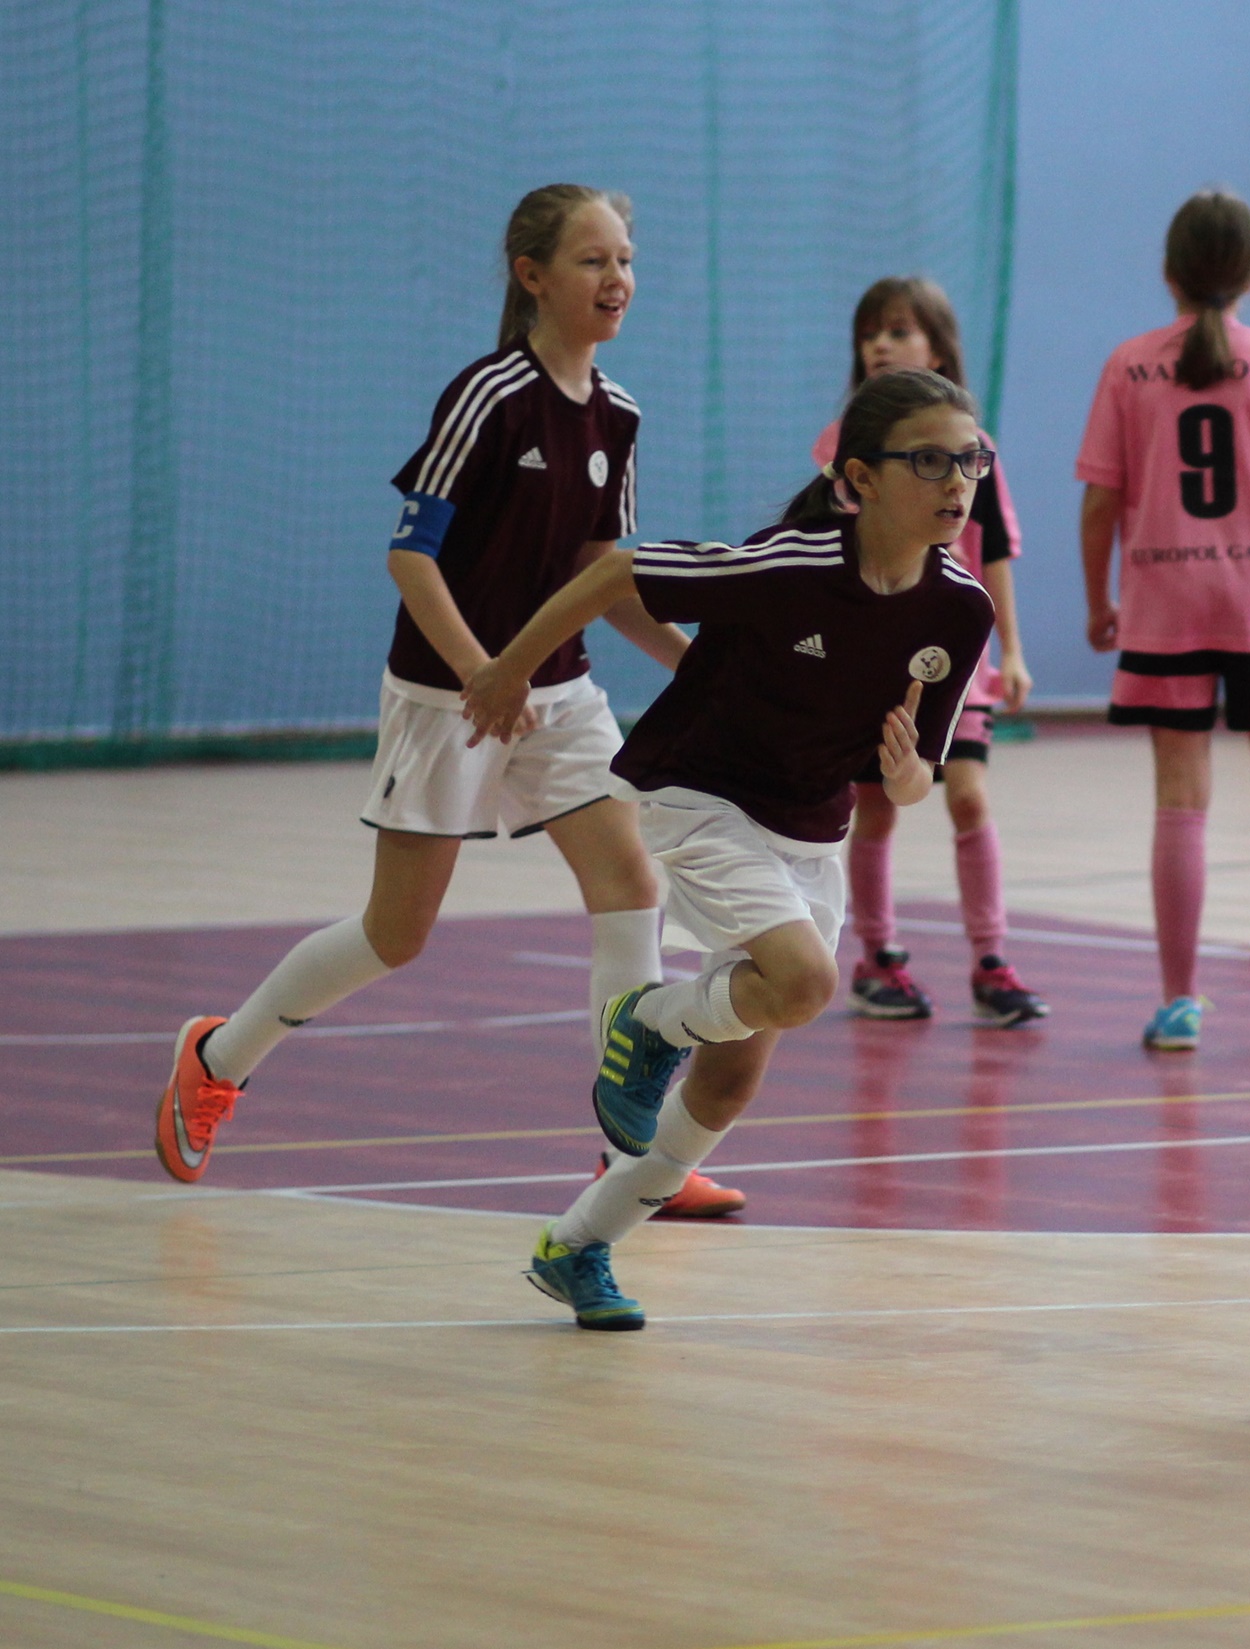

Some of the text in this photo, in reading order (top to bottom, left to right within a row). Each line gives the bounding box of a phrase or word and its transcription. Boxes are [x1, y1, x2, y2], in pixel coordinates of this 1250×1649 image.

[1177, 403, 1237, 519] 9
[392, 500, 420, 538] C
[793, 644, 827, 659] adidas
